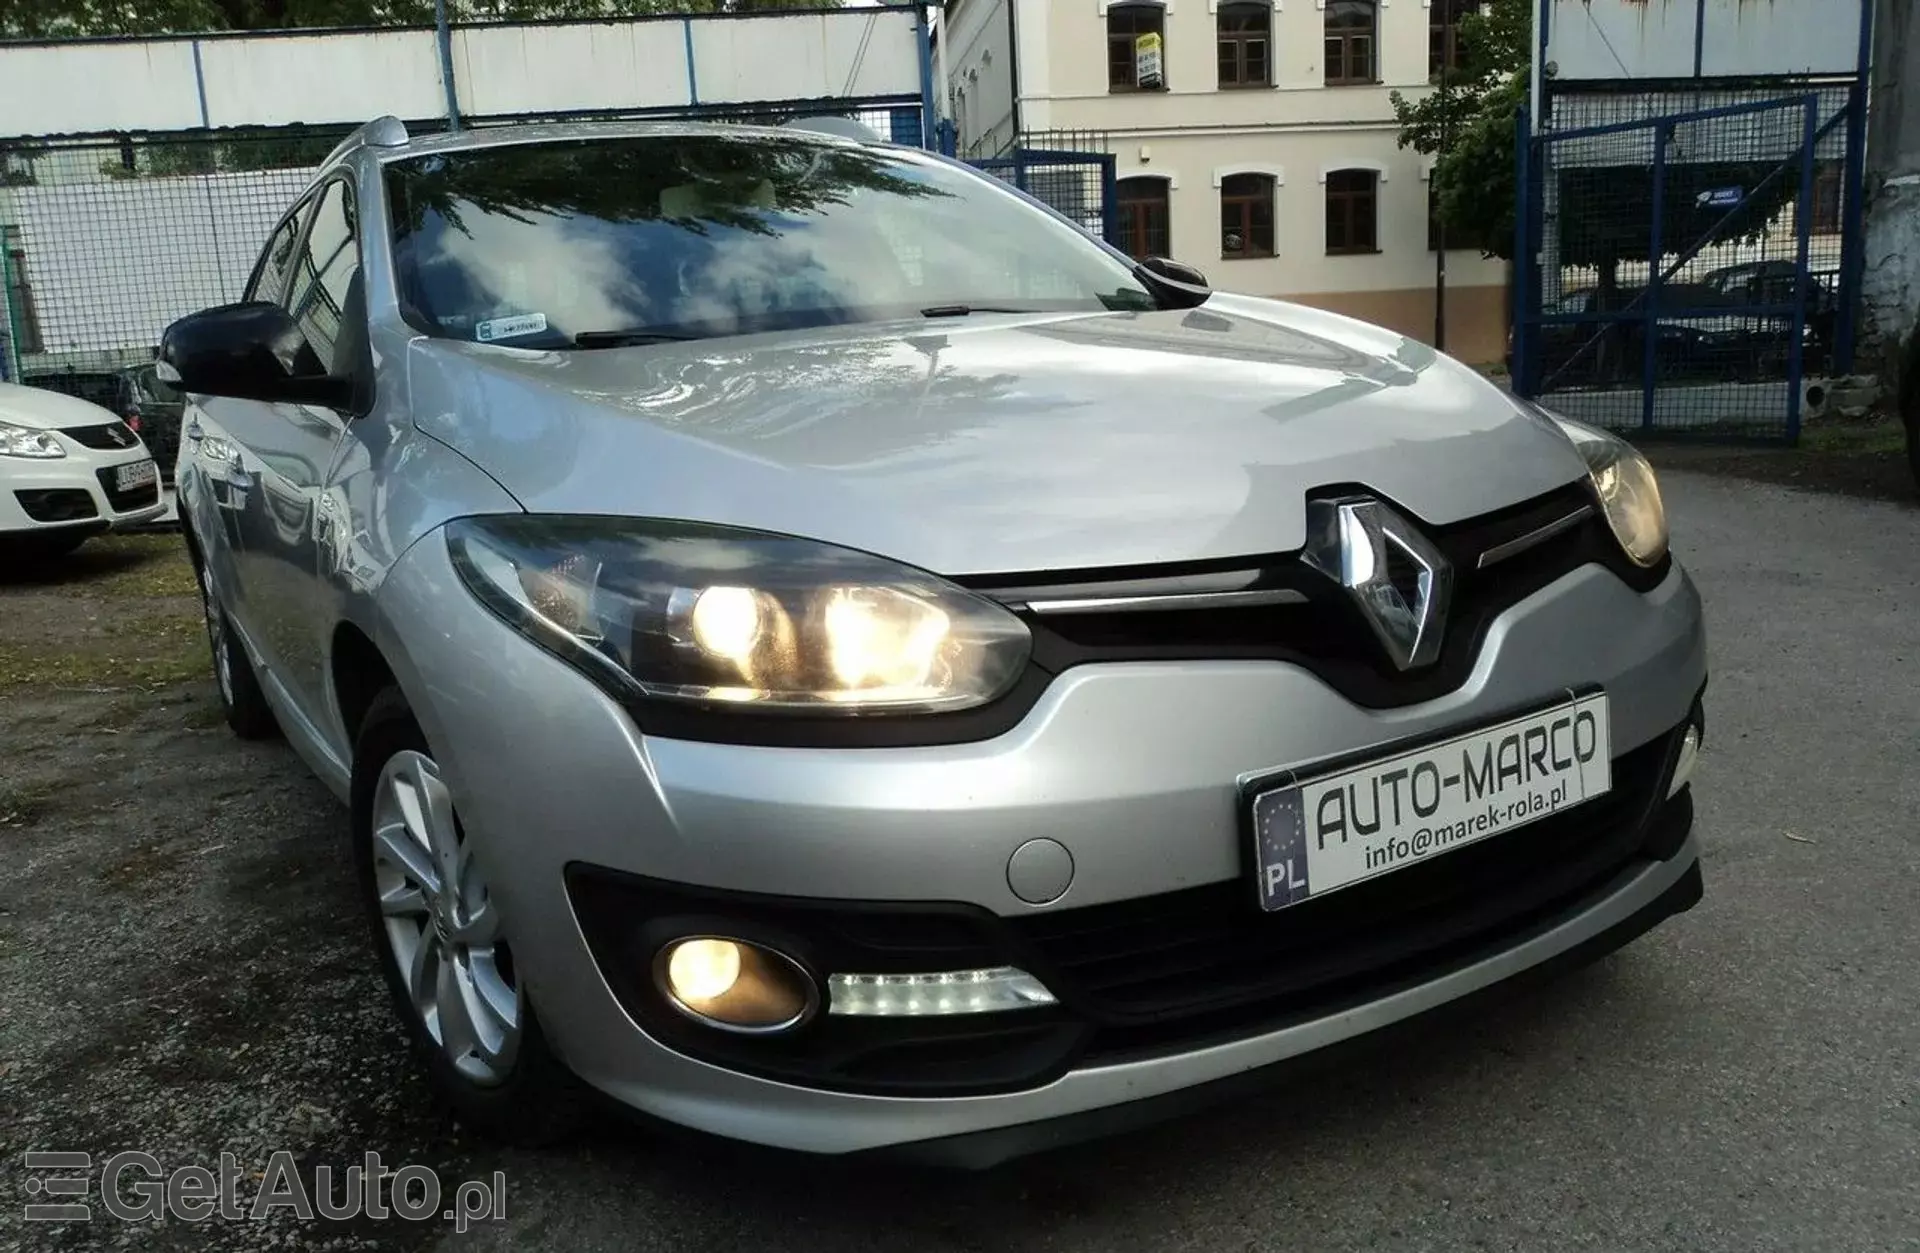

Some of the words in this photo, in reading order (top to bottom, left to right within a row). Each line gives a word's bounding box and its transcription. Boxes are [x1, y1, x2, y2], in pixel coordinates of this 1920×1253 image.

[1317, 710, 1596, 850] AUTO-MARCO
[1365, 779, 1567, 869] info@marek-rola.pl
[1266, 858, 1306, 897] PL
